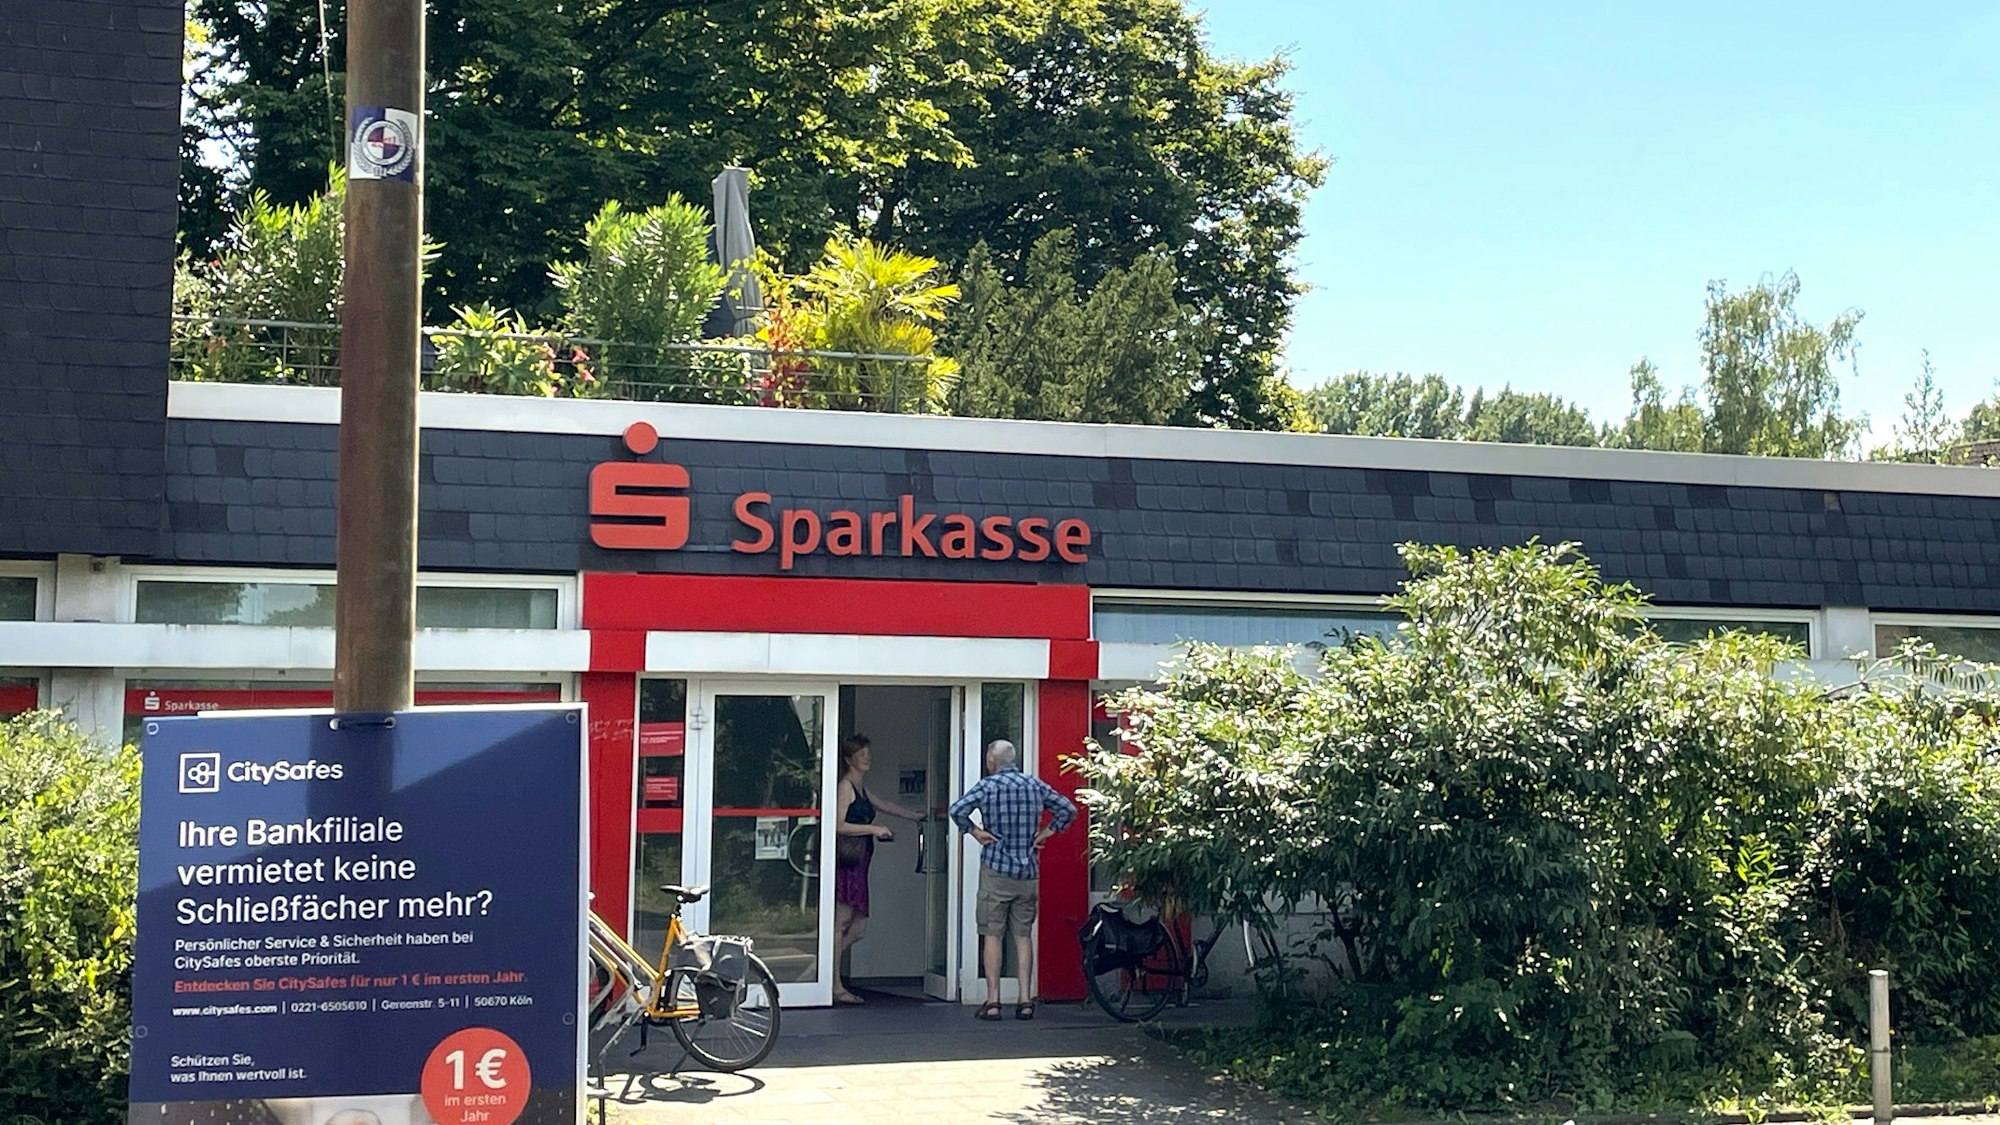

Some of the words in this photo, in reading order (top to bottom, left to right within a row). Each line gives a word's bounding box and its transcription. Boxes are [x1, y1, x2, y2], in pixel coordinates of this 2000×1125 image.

[731, 491, 1092, 571] Sparkasse
[164, 700, 219, 711] Sparkasse
[227, 759, 344, 786] CitySafes
[178, 820, 238, 848] Ihre
[247, 817, 403, 845] Bankfiliale
[177, 857, 325, 886] vermietet
[335, 855, 417, 881] keine
[176, 894, 390, 925] Schließfächer
[398, 889, 493, 917] mehr?
[175, 938, 262, 952] Persönlicher
[264, 936, 317, 949] Service
[320, 935, 330, 948] &
[333, 932, 402, 947] Sicherheit
[406, 931, 449, 945] haben
[452, 930, 474, 944] bei
[174, 955, 242, 972] CitySafes
[244, 953, 299, 968] oberste
[301, 952, 361, 966] Priorität.
[174, 979, 250, 993] Entdecken
[253, 978, 276, 991] Sie
[278, 975, 347, 992] CitySafes
[350, 974, 371, 988] für
[373, 975, 398, 987] nur
[412, 974, 421, 986] €
[424, 972, 442, 985] im
[444, 973, 491, 985] ersten
[172, 1004, 278, 1017] www.citysafes.com
[474, 996, 508, 1008] 50670
[509, 995, 534, 1007] Köln
[171, 1055, 230, 1068] Schützen
[232, 1053, 256, 1067] Sie,
[445, 1050, 465, 1090] 1
[475, 1048, 507, 1089] €
[171, 1073, 197, 1083] was
[198, 1071, 233, 1083] Ihnen
[236, 1068, 286, 1082] wertvoll
[444, 1095, 460, 1106] im
[463, 1094, 507, 1106] ersten
[461, 1110, 490, 1123] Jahr
